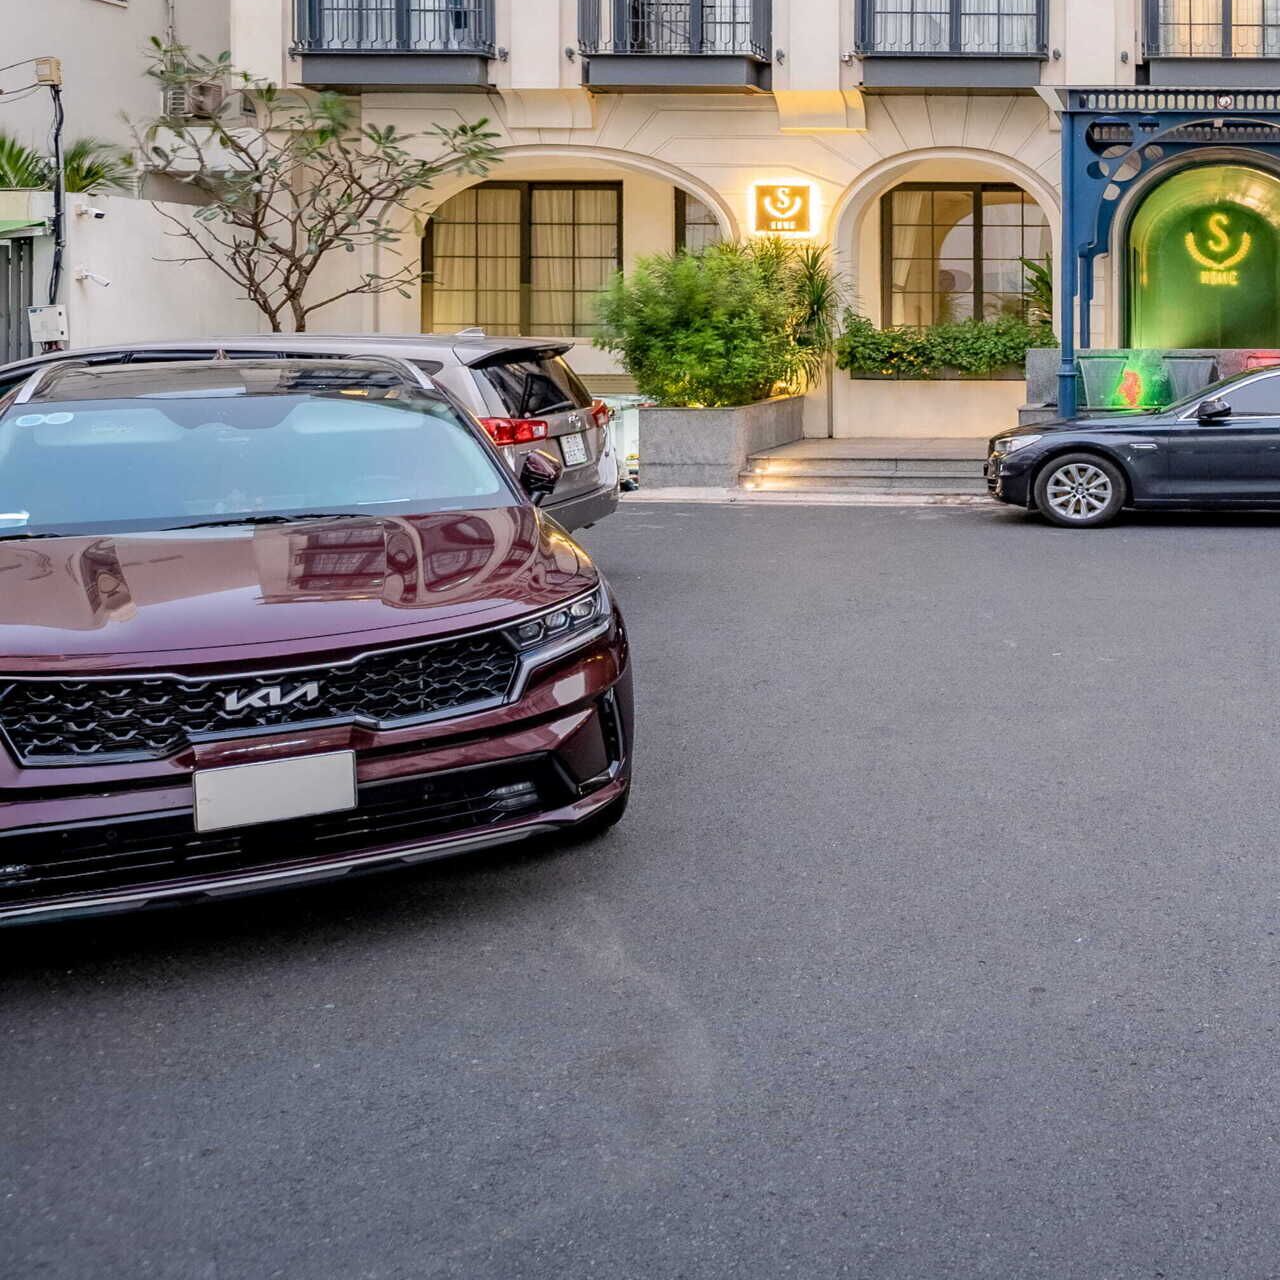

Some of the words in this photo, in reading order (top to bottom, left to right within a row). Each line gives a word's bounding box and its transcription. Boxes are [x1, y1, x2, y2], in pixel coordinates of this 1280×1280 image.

[776, 187, 791, 209] S
[1208, 213, 1230, 252] S
[225, 680, 319, 711] KIA
